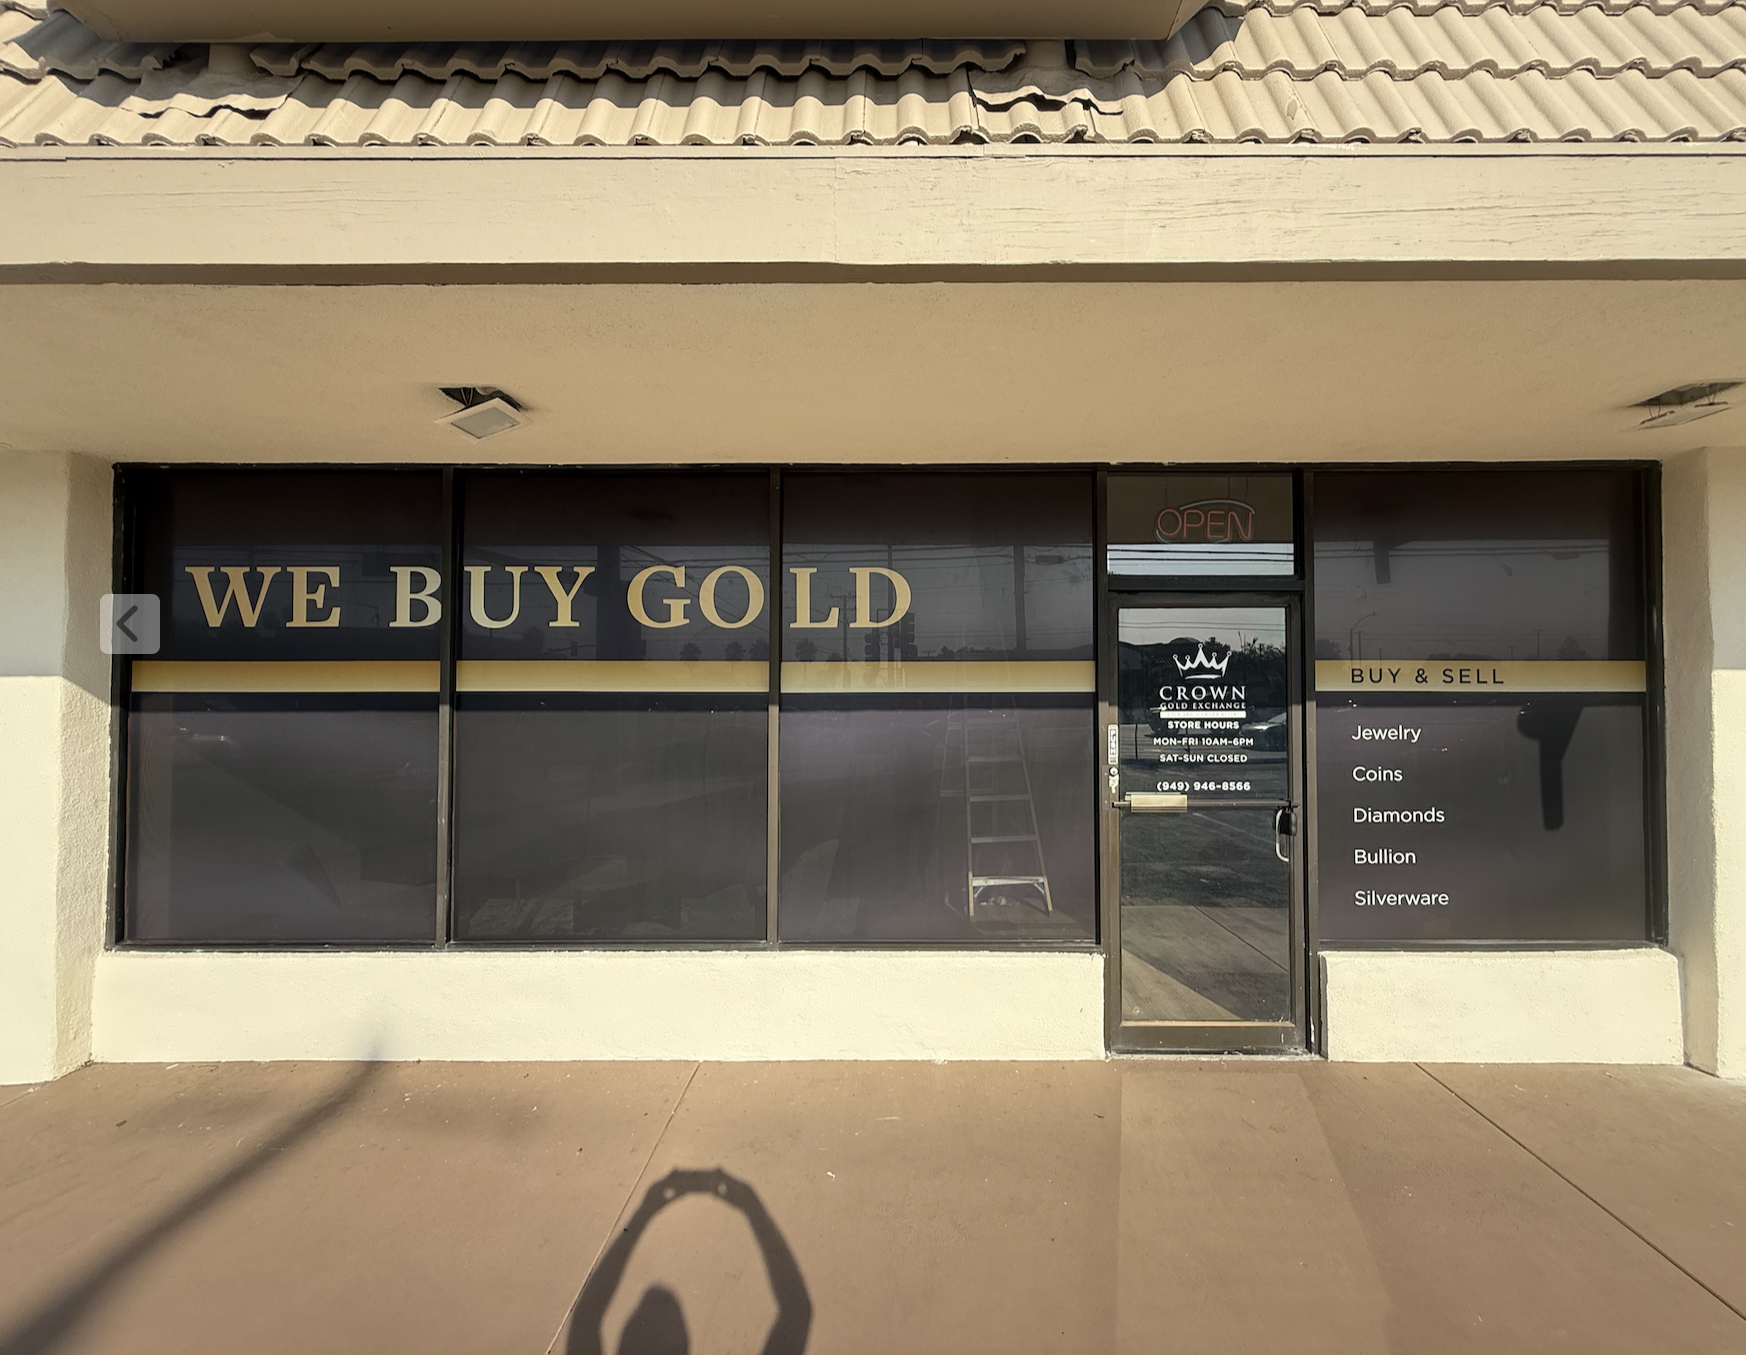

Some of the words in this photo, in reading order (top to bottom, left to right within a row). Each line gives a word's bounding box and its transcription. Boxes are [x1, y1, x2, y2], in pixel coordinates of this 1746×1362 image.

[1157, 508, 1254, 539] OPEN
[185, 566, 342, 629] WE
[389, 566, 596, 629] BUY
[626, 565, 912, 629] GOLD
[1351, 668, 1401, 683] BUY
[1415, 668, 1428, 684] &
[1442, 668, 1504, 684] SELL
[1159, 685, 1246, 700] CROWN
[1160, 702, 1188, 710] GOLD
[1167, 721, 1201, 729] STORE
[1204, 721, 1240, 729] HOURS
[1153, 737, 1199, 746] MON-FRI
[1201, 737, 1254, 746] 10AM-6PM
[1352, 725, 1421, 743] Jewelry
[1159, 754, 1204, 763] SAT-SUN
[1206, 754, 1248, 763] CLOSED
[1352, 766, 1403, 781] Coins
[1156, 781, 1190, 791] (949)
[1193, 781, 1251, 791] 946-8566
[1353, 807, 1445, 823] Diamonds
[1354, 849, 1416, 864] Bullion
[1354, 891, 1449, 906] Silverware
